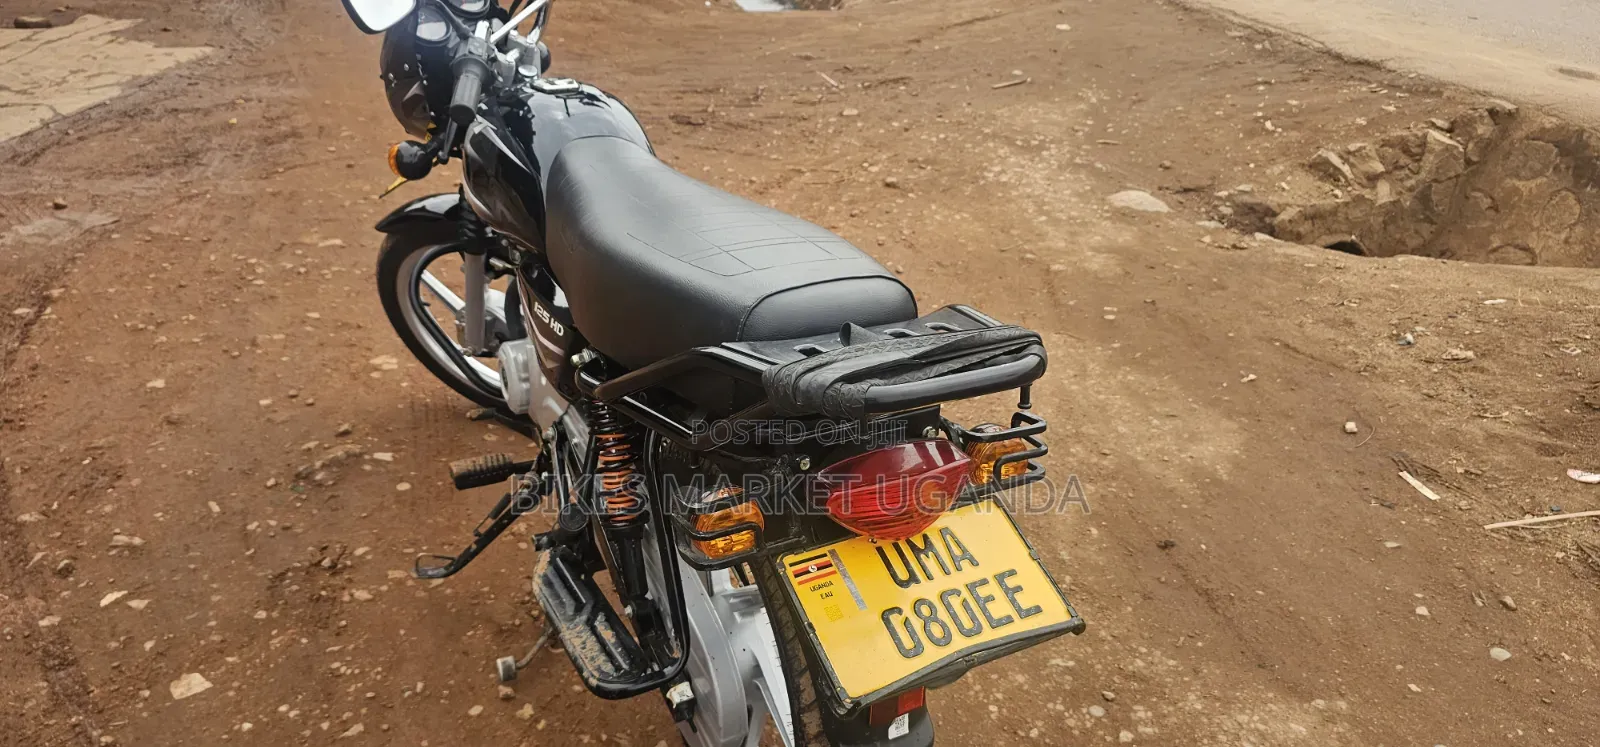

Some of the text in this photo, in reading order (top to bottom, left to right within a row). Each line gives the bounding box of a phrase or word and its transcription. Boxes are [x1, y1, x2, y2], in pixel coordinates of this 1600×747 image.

[534, 301, 564, 337] 125 HD
[875, 526, 980, 589] UMA
[809, 580, 834, 592] UGANDA
[820, 591, 833, 600] EAU
